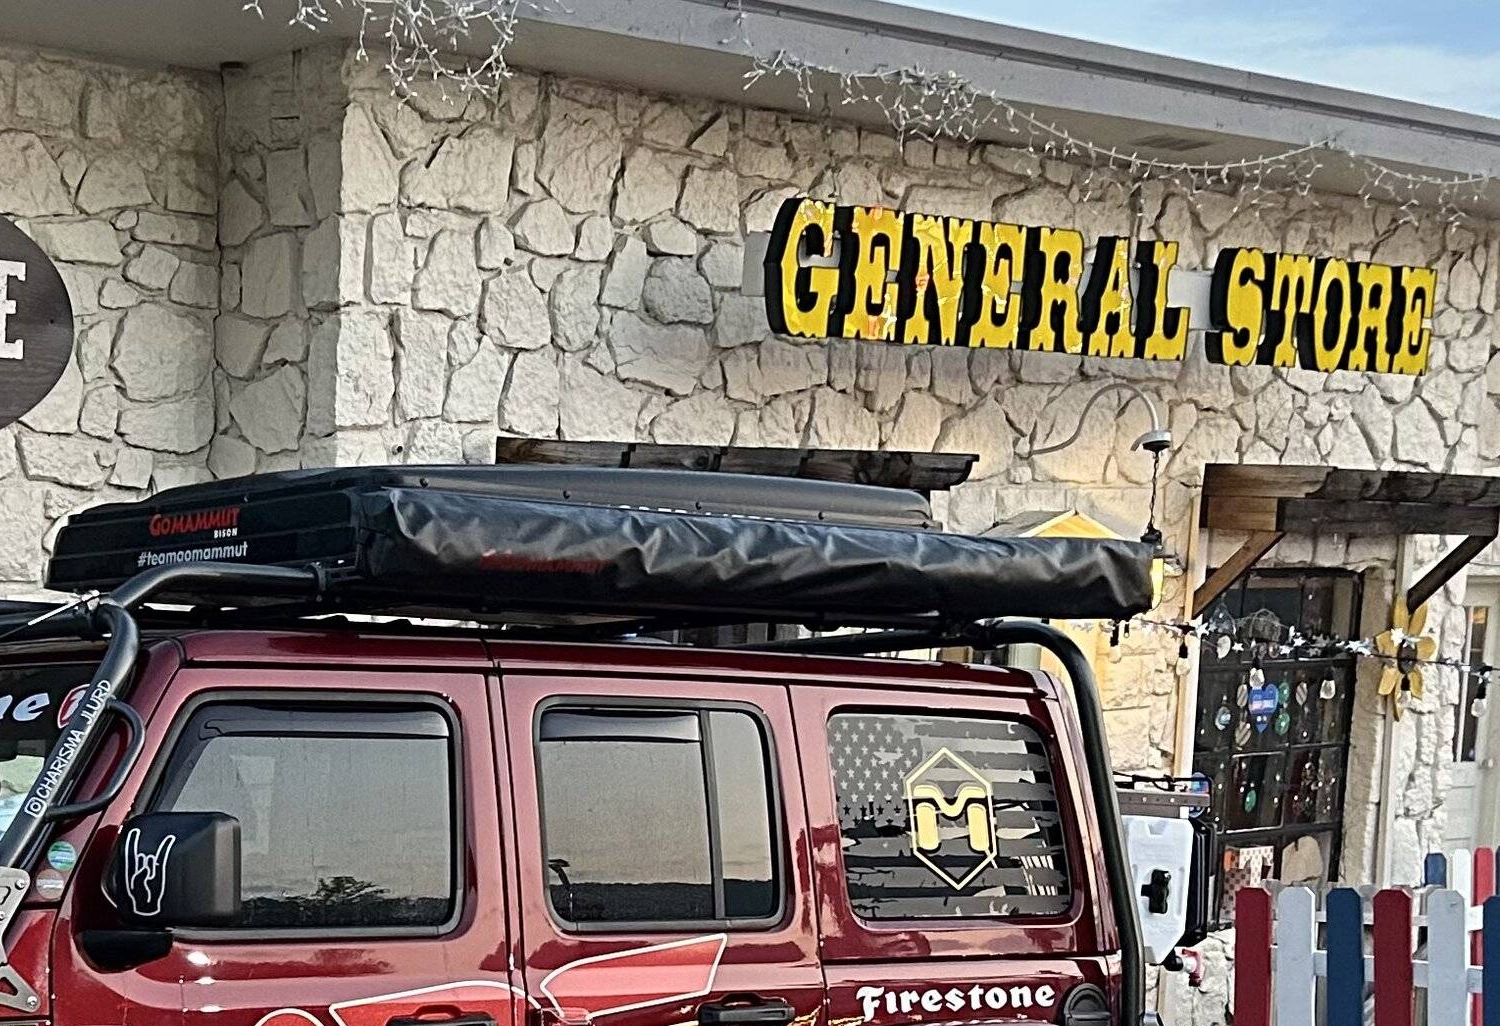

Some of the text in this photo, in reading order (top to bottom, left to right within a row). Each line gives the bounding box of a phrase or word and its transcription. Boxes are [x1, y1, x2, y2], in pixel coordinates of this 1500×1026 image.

[764, 198, 1438, 376] GENERAL STORE
[213, 527, 238, 539] BISON
[856, 983, 1056, 1023] Firestone
